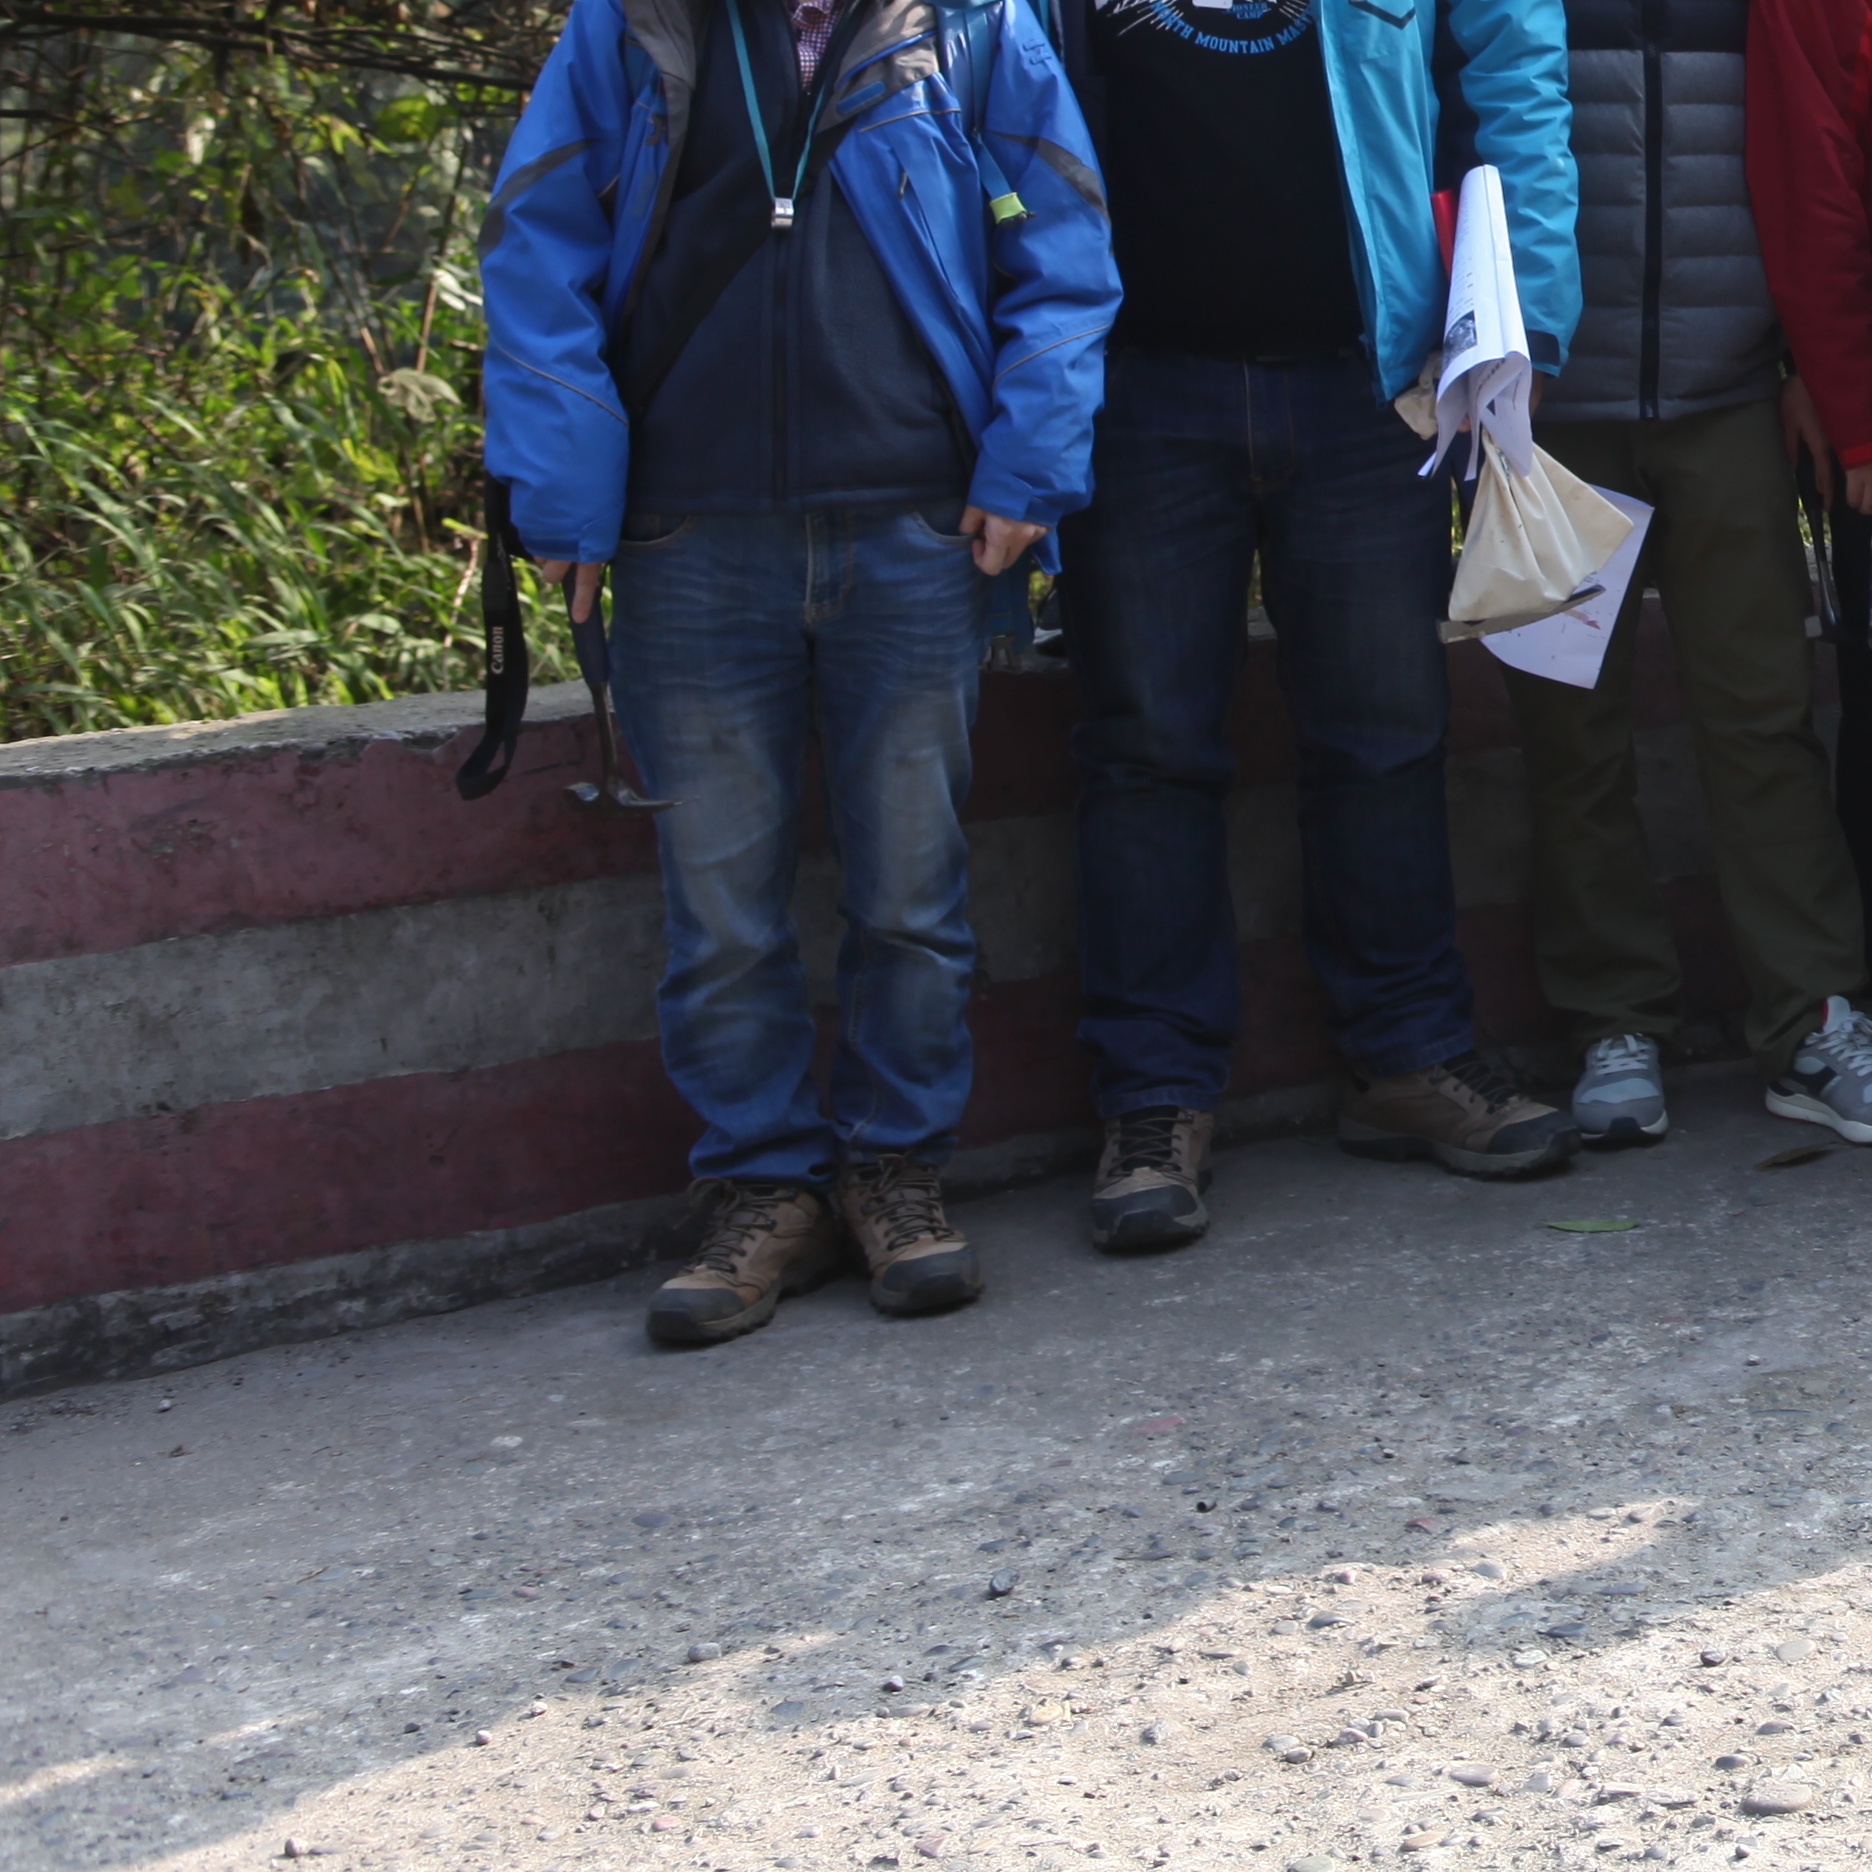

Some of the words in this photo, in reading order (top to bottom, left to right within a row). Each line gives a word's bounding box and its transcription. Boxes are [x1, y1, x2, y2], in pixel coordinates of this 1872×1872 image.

[1150, 0, 1194, 39] NORTH
[1195, 31, 1275, 54] MOUNTAIN
[490, 626, 505, 675] Canon
